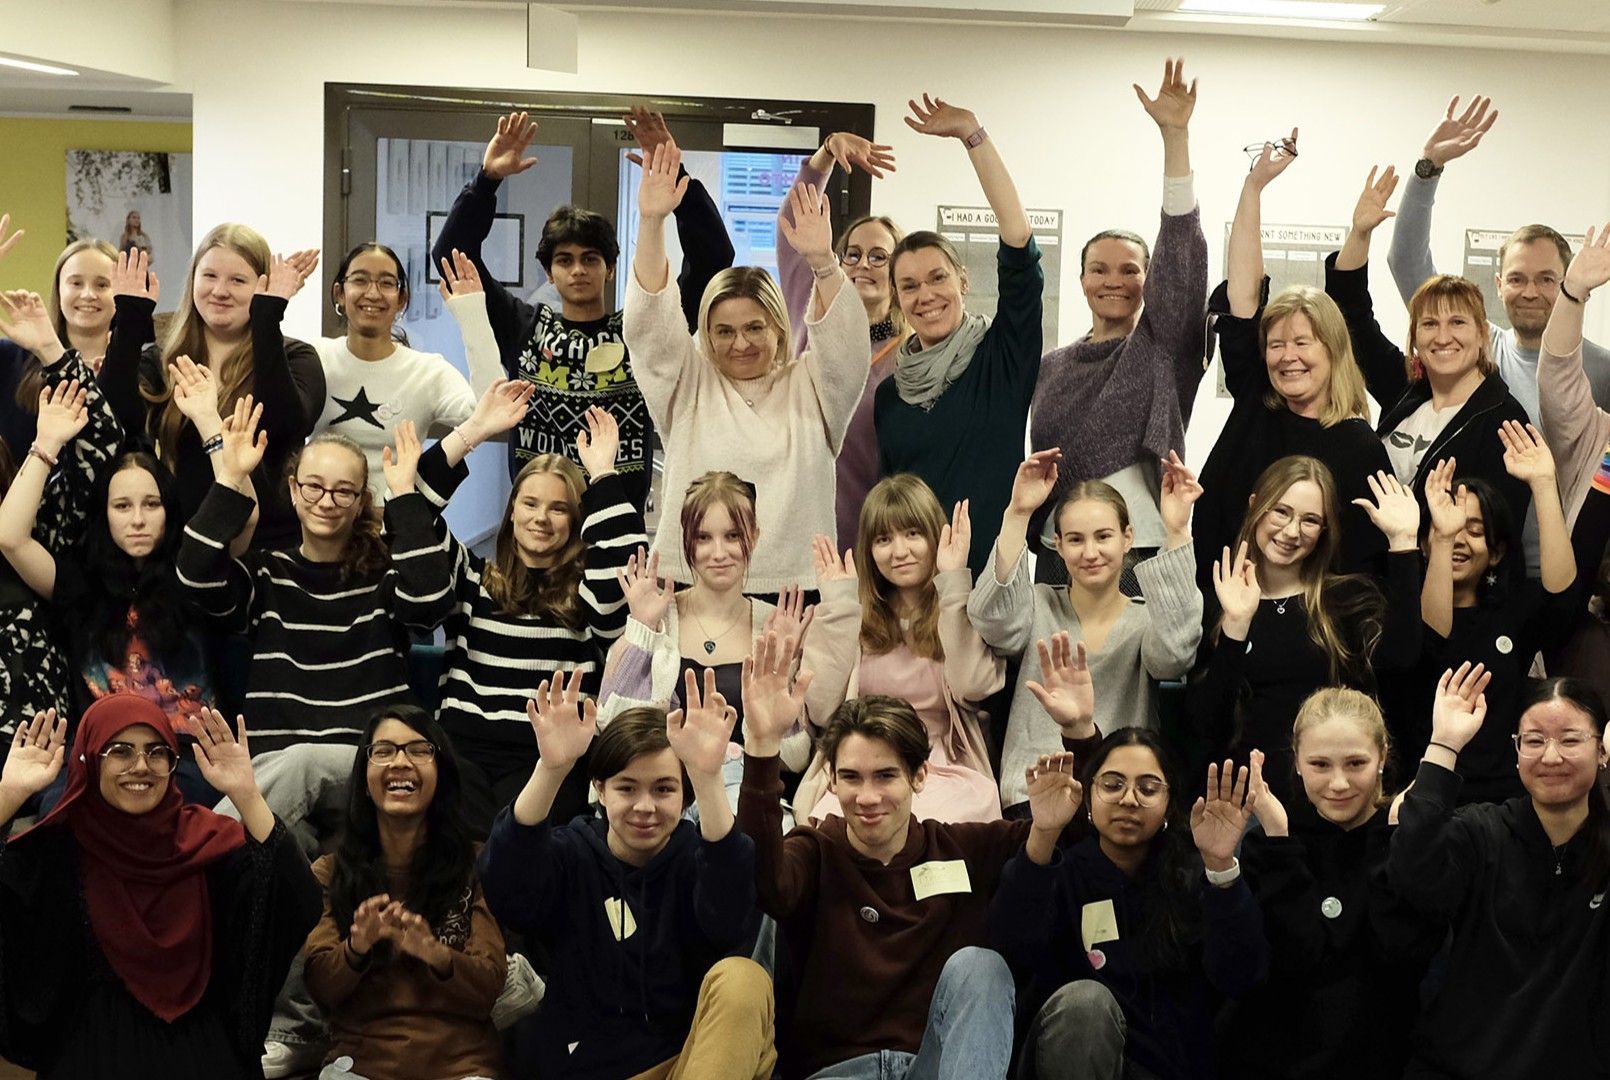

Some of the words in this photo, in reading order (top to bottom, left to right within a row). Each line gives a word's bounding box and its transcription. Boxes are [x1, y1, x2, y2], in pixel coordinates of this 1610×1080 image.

[956, 213, 973, 223] HAD
[976, 214, 982, 223] A
[1029, 215, 1056, 225] TODAY
[1278, 230, 1321, 241] SOMETHING
[1324, 232, 1342, 242] NEW
